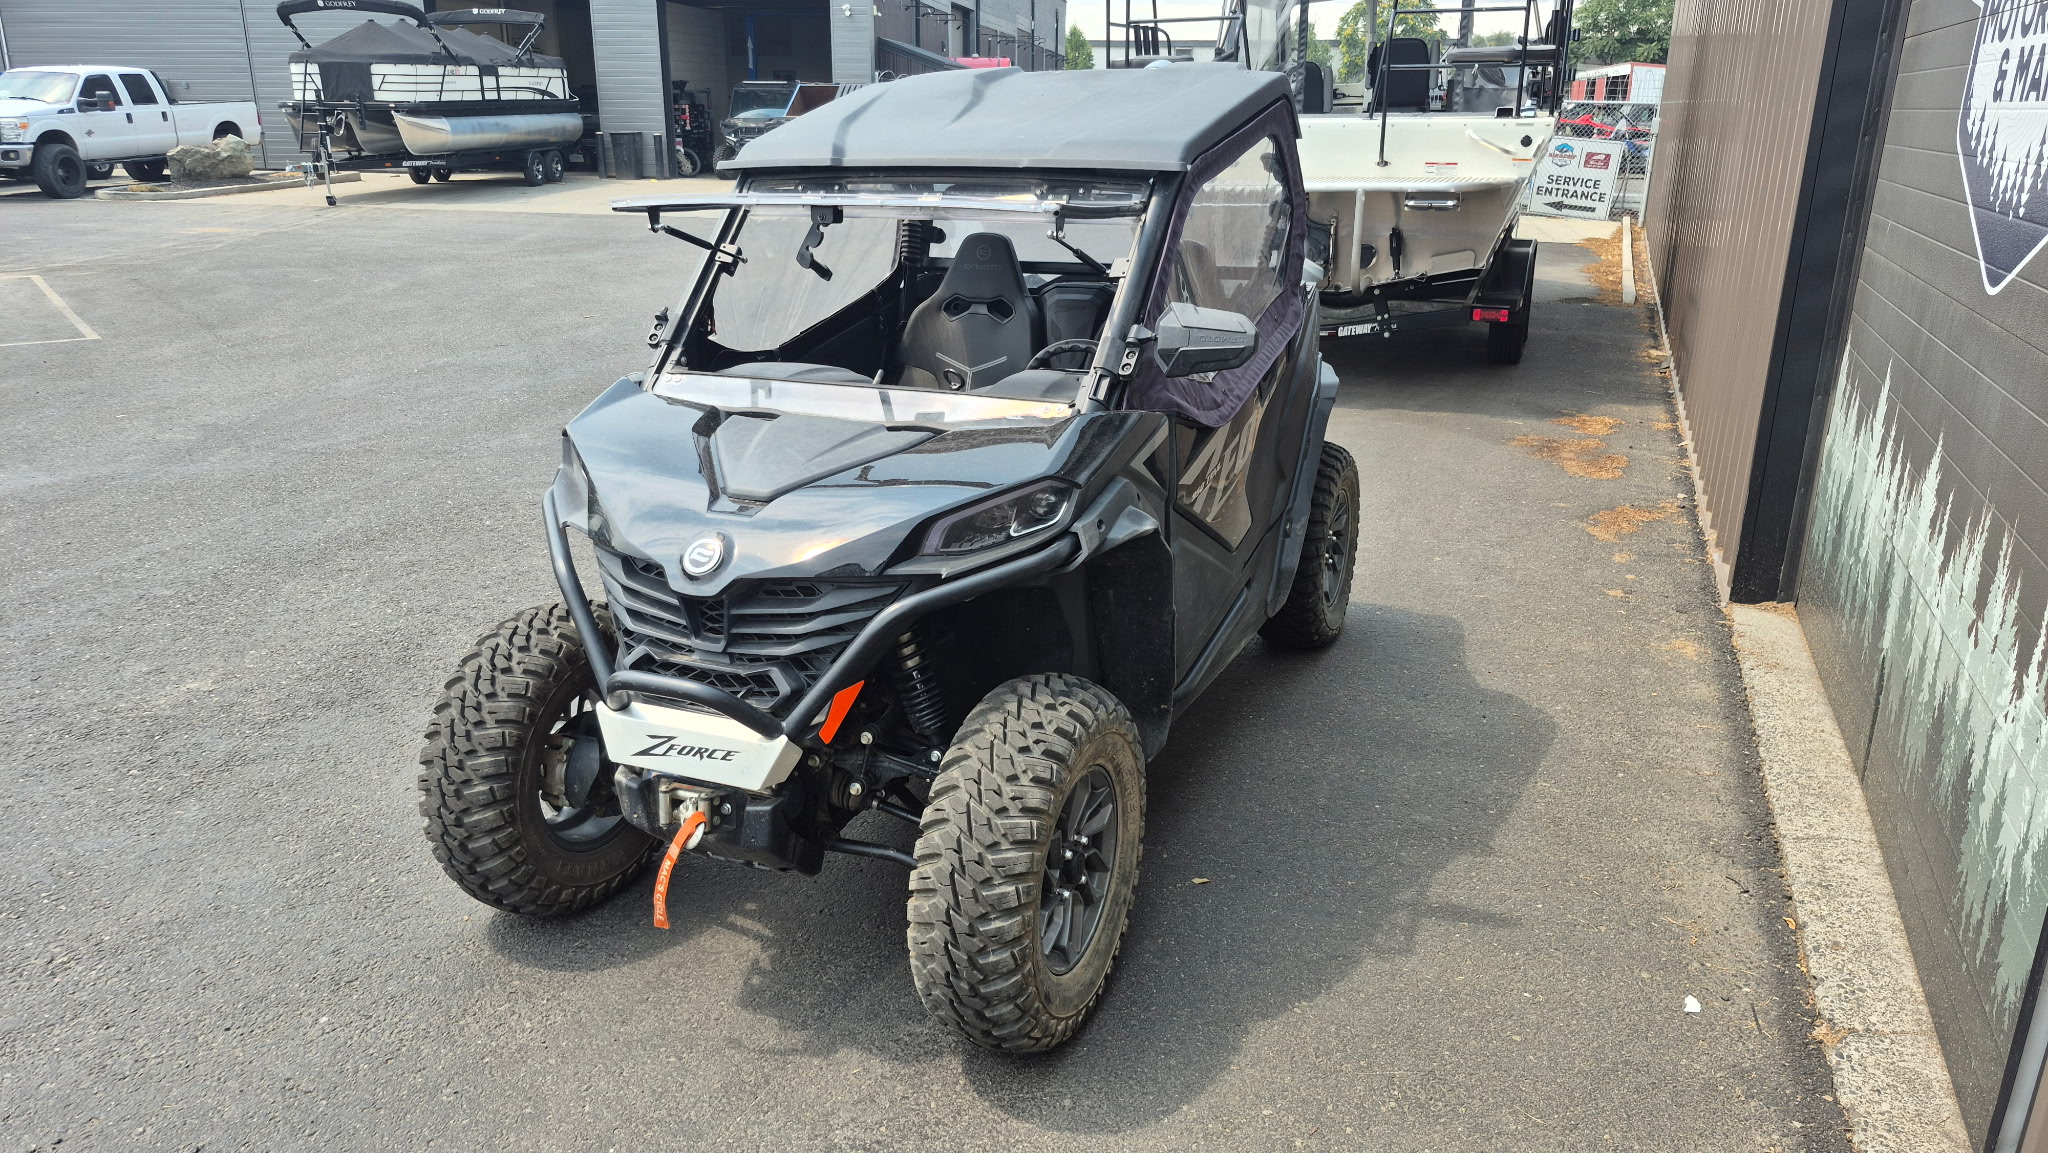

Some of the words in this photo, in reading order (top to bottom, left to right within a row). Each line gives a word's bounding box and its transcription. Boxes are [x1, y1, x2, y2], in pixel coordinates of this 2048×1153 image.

[1983, 0, 2048, 44] MOTOR
[1993, 48, 2010, 103] &
[2009, 43, 2048, 102] MA
[1536, 186, 1607, 203] ENTRANCE
[1547, 174, 1602, 190] SERVICE
[1338, 322, 1373, 337] GATEWAY
[630, 734, 741, 762] ZFORCE
[656, 893, 665, 922] CYCLE
